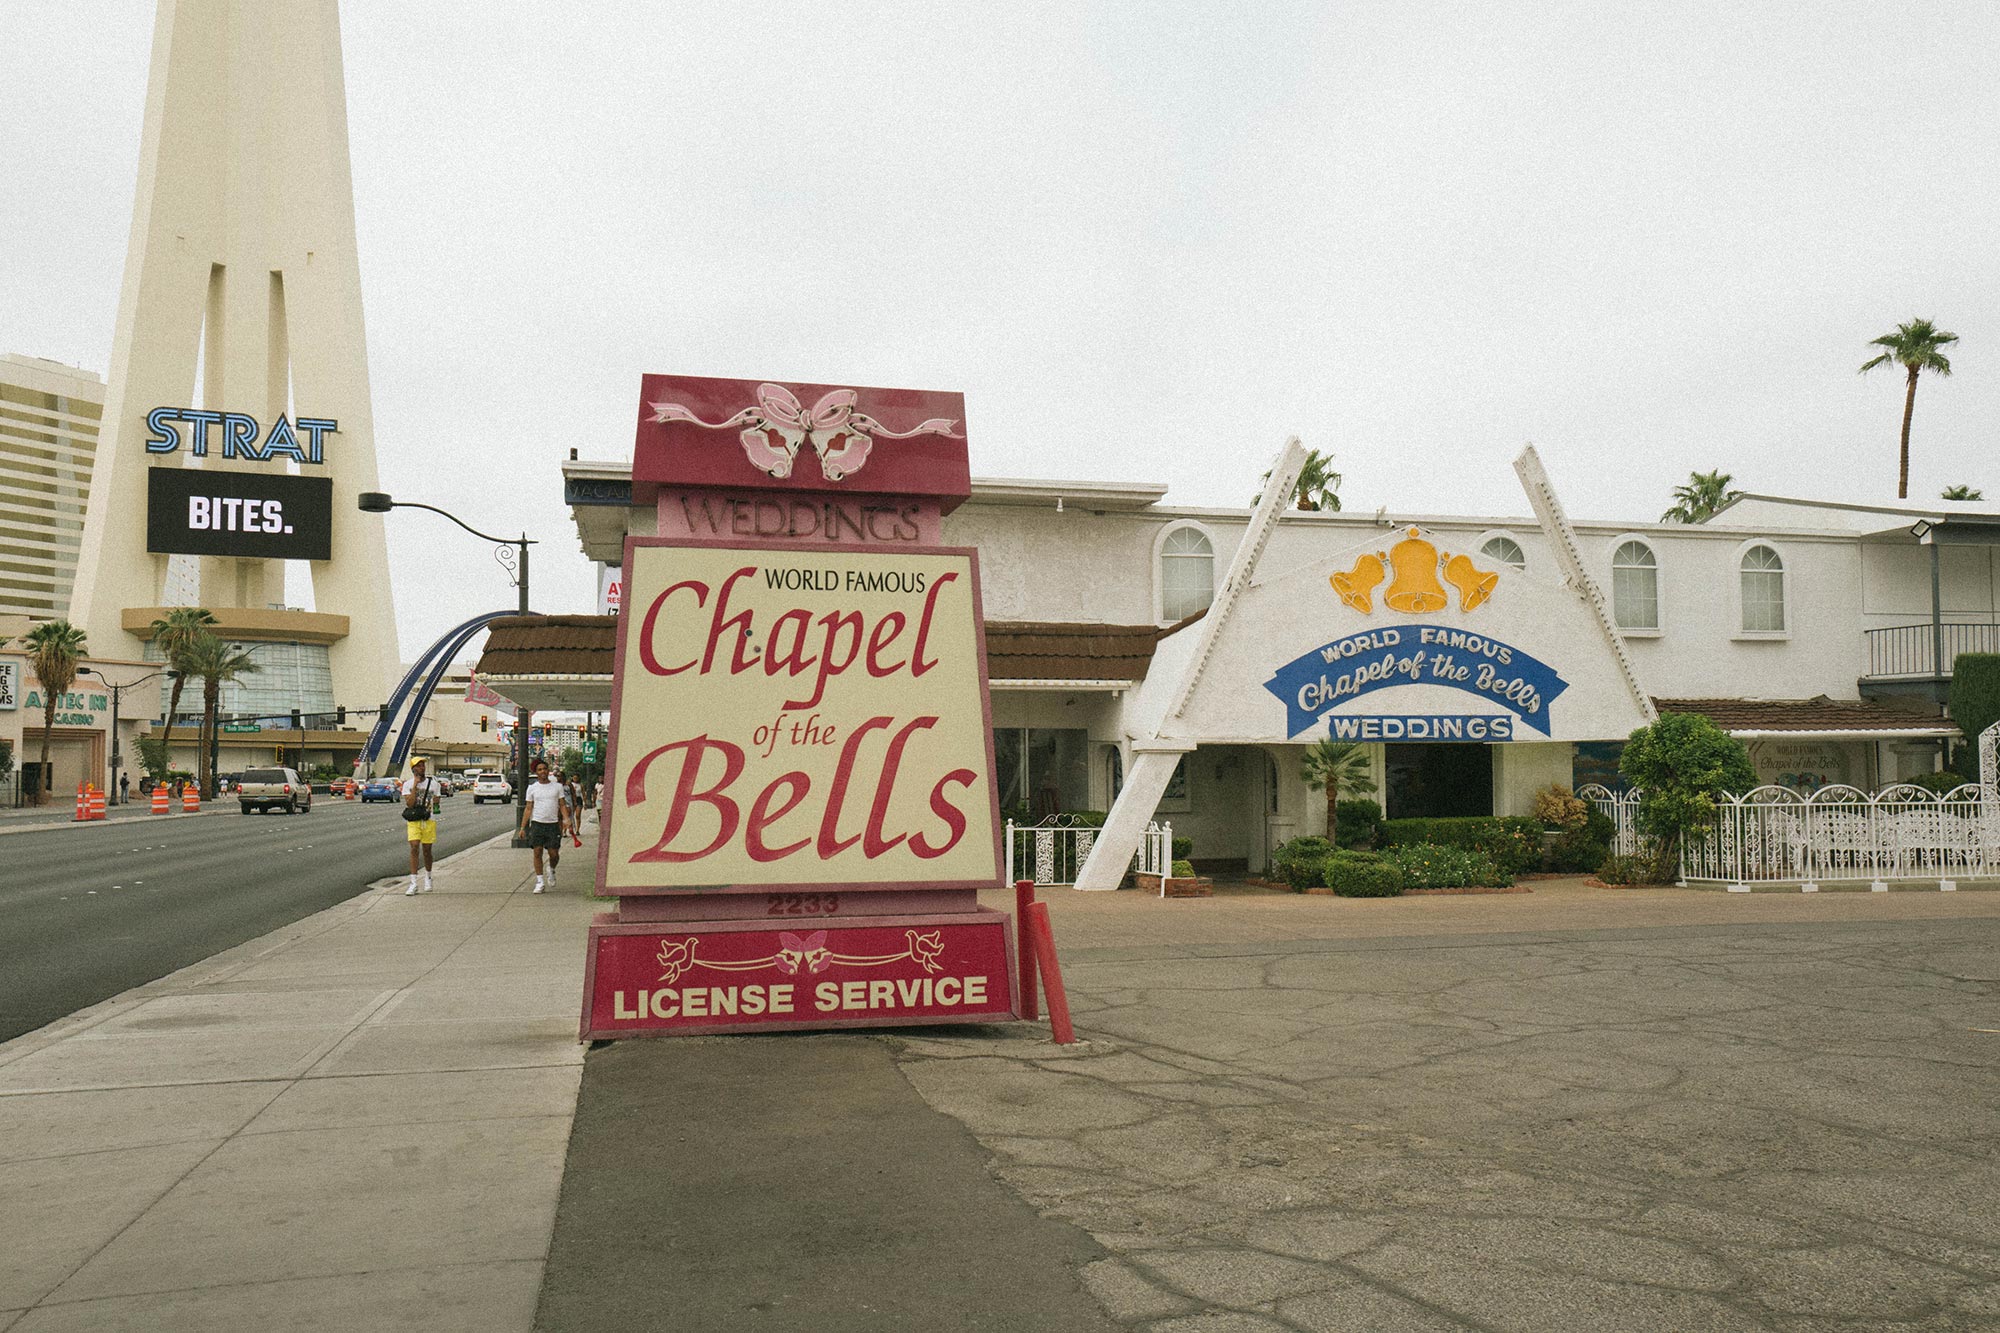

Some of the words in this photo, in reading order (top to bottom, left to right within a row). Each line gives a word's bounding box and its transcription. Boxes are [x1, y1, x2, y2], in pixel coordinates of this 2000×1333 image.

[146, 407, 338, 465] STRAT
[188, 495, 294, 534] BITES.
[681, 496, 920, 542] WEDDINGS
[764, 568, 839, 592] WORLD
[845, 570, 926, 594] FAMOUS
[638, 566, 959, 711] Chapel
[1320, 629, 1400, 665] WORLD
[1420, 628, 1513, 665] FAMOUS
[89, 694, 107, 711] INN
[1297, 653, 1395, 712] Chapel
[1397, 650, 1427, 680] of
[1430, 653, 1471, 682] the
[1476, 663, 1541, 714] Bells
[53, 713, 94, 726] CASINO
[752, 713, 788, 758] of
[790, 714, 836, 746] the
[1333, 718, 1512, 739] WEDDINGS
[625, 716, 978, 864] Bells
[767, 894, 839, 915] 2233
[613, 983, 795, 1020] LICENSE
[813, 976, 989, 1012] SERVICE
